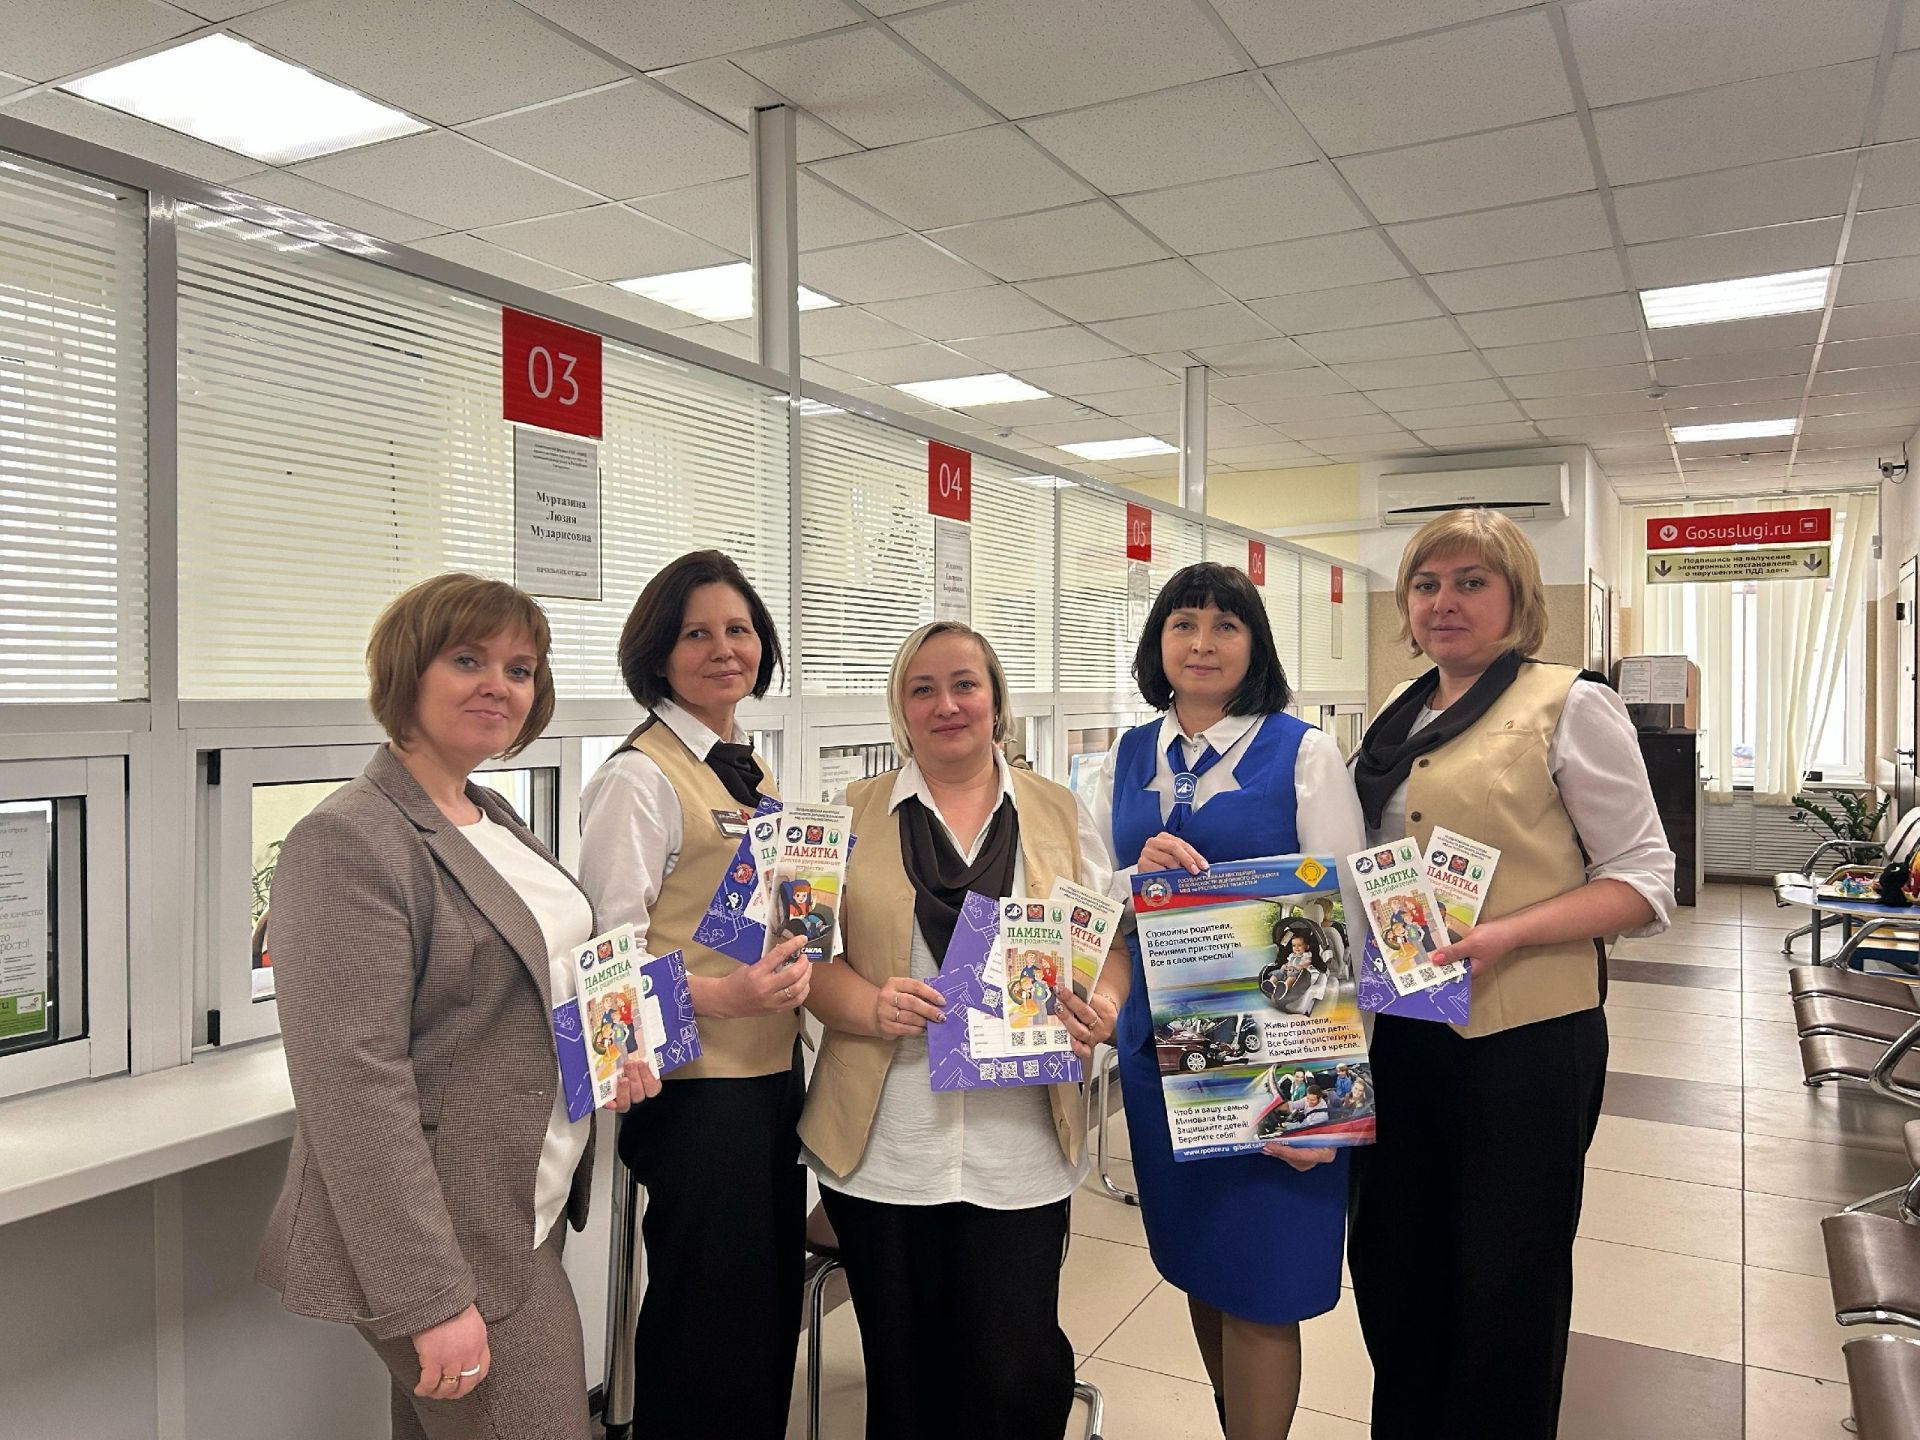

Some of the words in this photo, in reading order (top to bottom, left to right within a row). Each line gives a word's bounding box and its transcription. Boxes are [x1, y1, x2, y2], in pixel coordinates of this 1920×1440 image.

[528, 346, 579, 406] 03
[939, 462, 963, 501] 04
[536, 491, 587, 509] Муртазина
[530, 524, 592, 543] Мударисовна
[1133, 519, 1146, 547] 05
[1685, 523, 1792, 541] Gosuslugi.ru
[1252, 552, 1263, 575] 06
[1683, 556, 1731, 564] Подпишись
[1745, 554, 1791, 563] получение
[1733, 560, 1798, 569] постановлений
[1692, 569, 1743, 578] нарушениях
[784, 845, 839, 859] ПАМЯТКА
[1364, 867, 1419, 891] ПАМЯТКА
[1426, 865, 1479, 894] ПАМЯТКА
[1007, 927, 1063, 940] ПАМЯТКА
[1071, 925, 1102, 947] ЯТКА
[1146, 927, 1189, 939] Спокойны
[1147, 940, 1154, 948] В
[1154, 934, 1212, 947] безопасности
[1149, 948, 1187, 958] Ремнями
[1188, 942, 1242, 954] пристегнуты
[1150, 959, 1165, 967] Все
[1172, 956, 1197, 965] своих
[1198, 951, 1234, 963] креслах!
[584, 959, 633, 989] ПАМЯТКА
[1264, 1022, 1289, 1030] Живы
[1265, 1031, 1277, 1039] Не
[1278, 1027, 1327, 1038] пострадали
[1282, 1038, 1305, 1046] были
[1269, 1047, 1303, 1057] Каждый
[1303, 1045, 1320, 1053] был
[1322, 1044, 1327, 1052] в
[1174, 1107, 1194, 1117] Чтоб
[1201, 1106, 1222, 1115] вашу
[1223, 1103, 1249, 1112] семью
[1175, 1116, 1216, 1126] Миновала
[1177, 1123, 1223, 1135] Защищайте
[1223, 1121, 1250, 1131] детей!
[1178, 1133, 1214, 1145] Берегите
[1216, 1131, 1236, 1140] себя!
